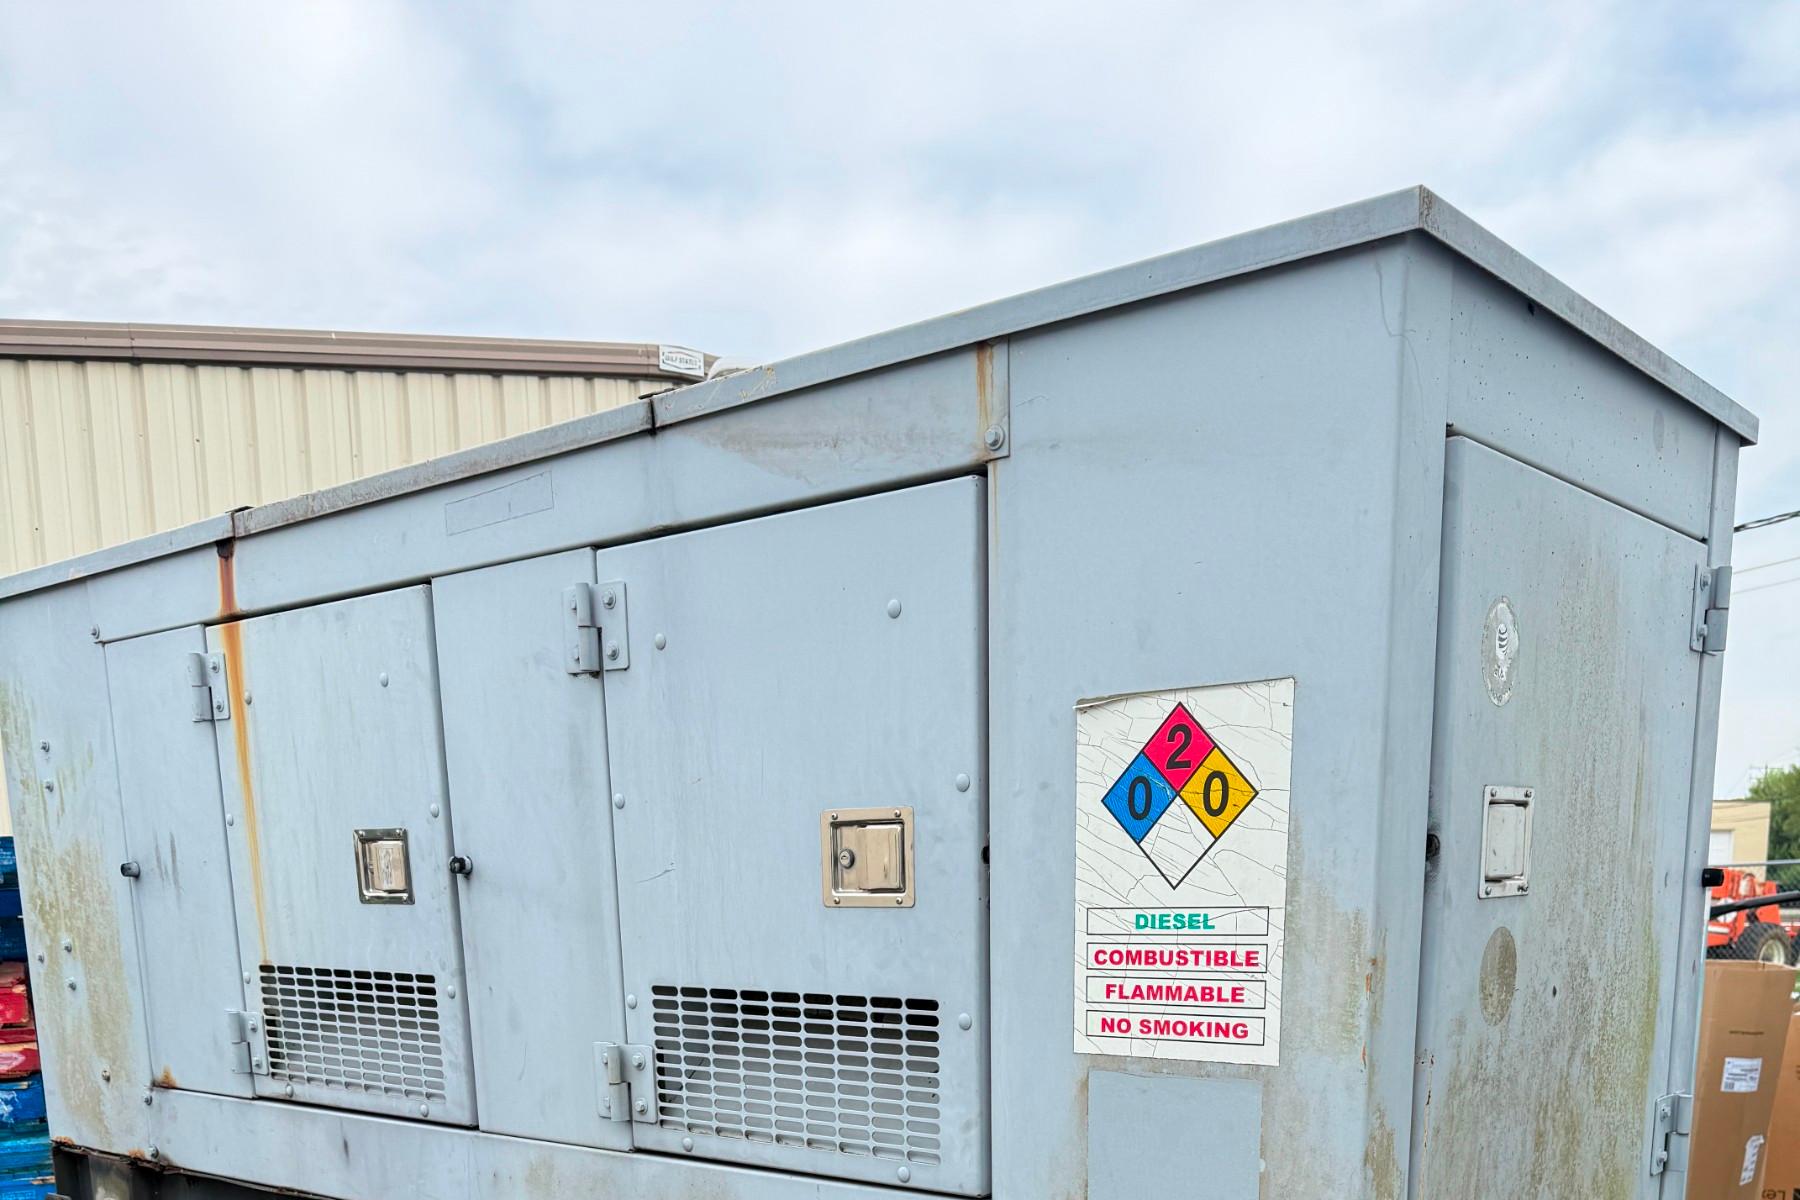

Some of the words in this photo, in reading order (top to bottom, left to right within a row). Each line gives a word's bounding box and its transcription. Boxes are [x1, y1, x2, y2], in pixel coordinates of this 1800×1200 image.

[1166, 723, 1192, 770] 2
[1127, 775, 1152, 821] 0
[1202, 770, 1229, 817] 0
[1135, 913, 1216, 930] DIESEL
[1094, 949, 1260, 967] COMBUSTIBLE
[1105, 983, 1246, 1003] FLAMMABLE
[1101, 1017, 1132, 1033] NO
[1139, 1018, 1249, 1039] SMOKING
